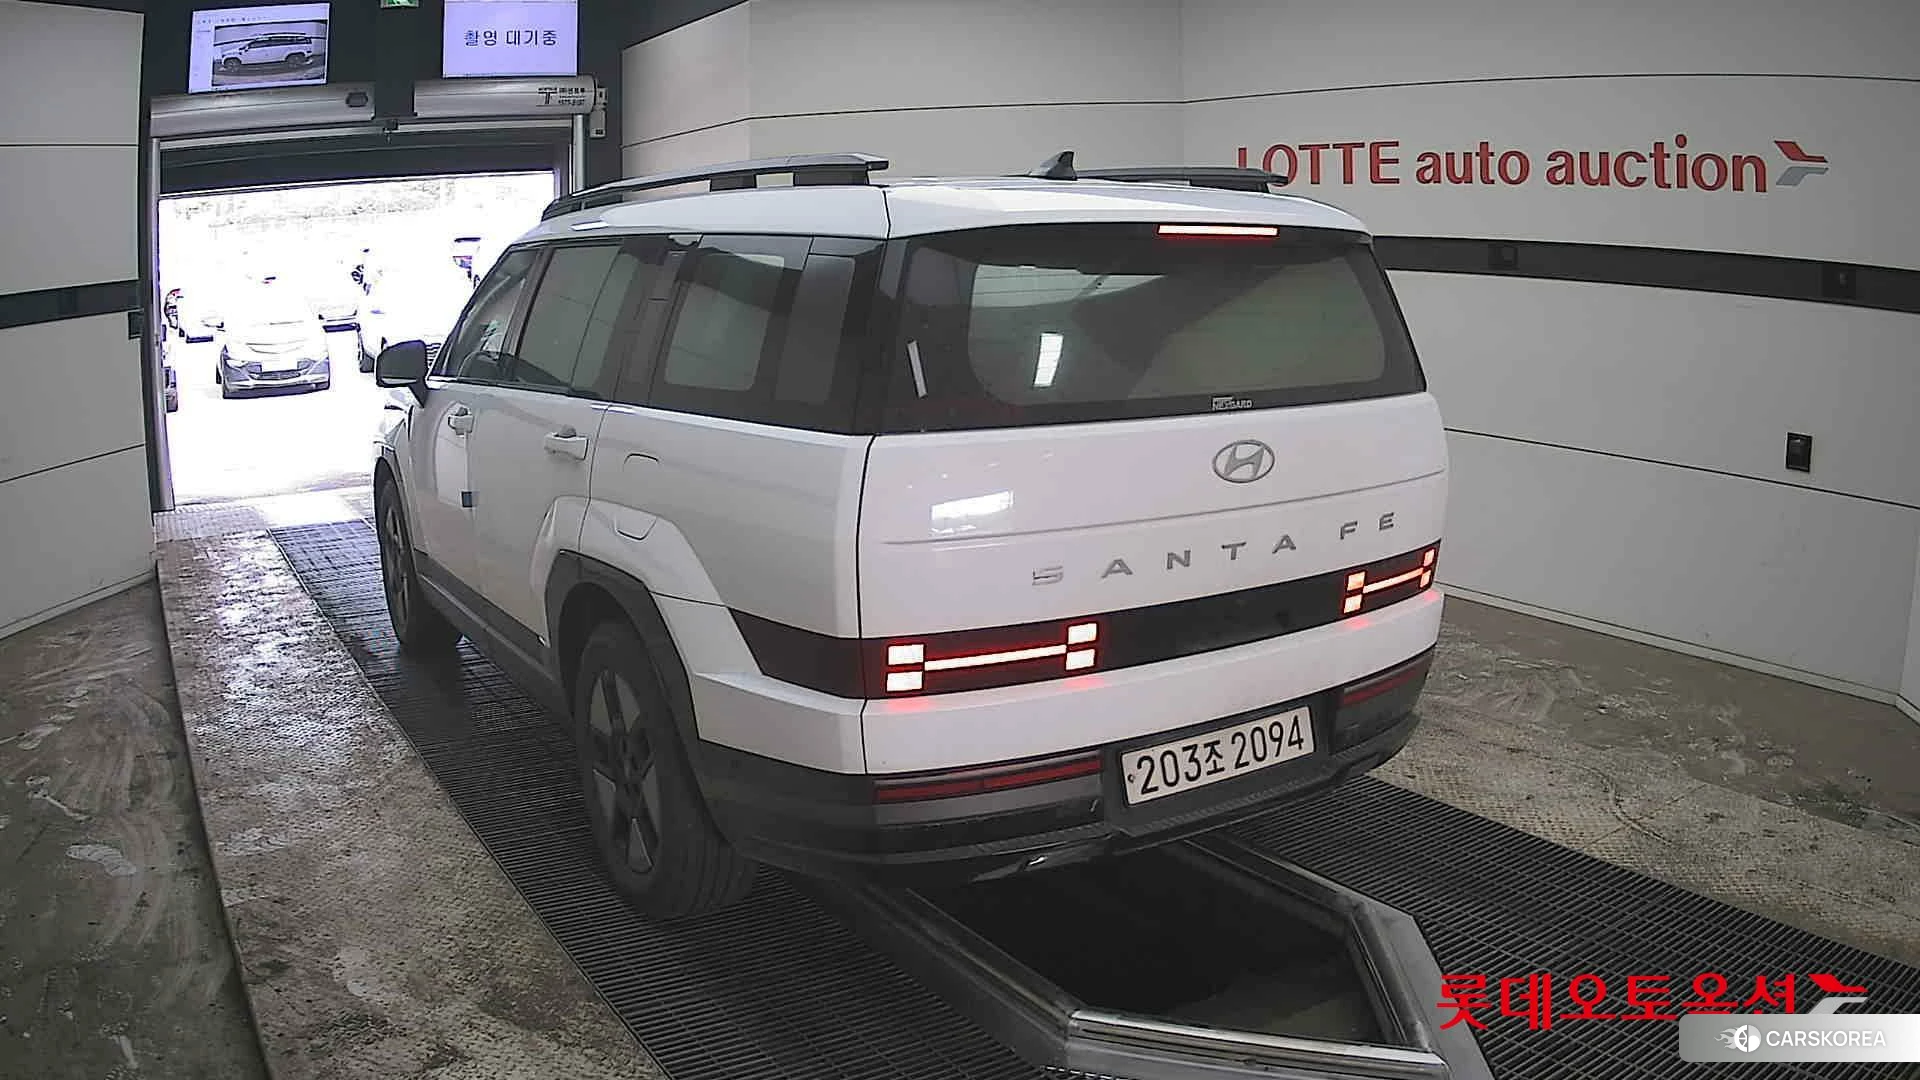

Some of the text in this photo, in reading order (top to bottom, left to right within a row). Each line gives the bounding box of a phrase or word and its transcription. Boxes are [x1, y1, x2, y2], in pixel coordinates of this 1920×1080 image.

[464, 29, 557, 47] 촬영 대기중
[1416, 142, 1530, 186] auto
[1546, 134, 1768, 193] auction
[1032, 512, 1395, 587] SANTA FE
[1137, 715, 1304, 795] 203조 2094
